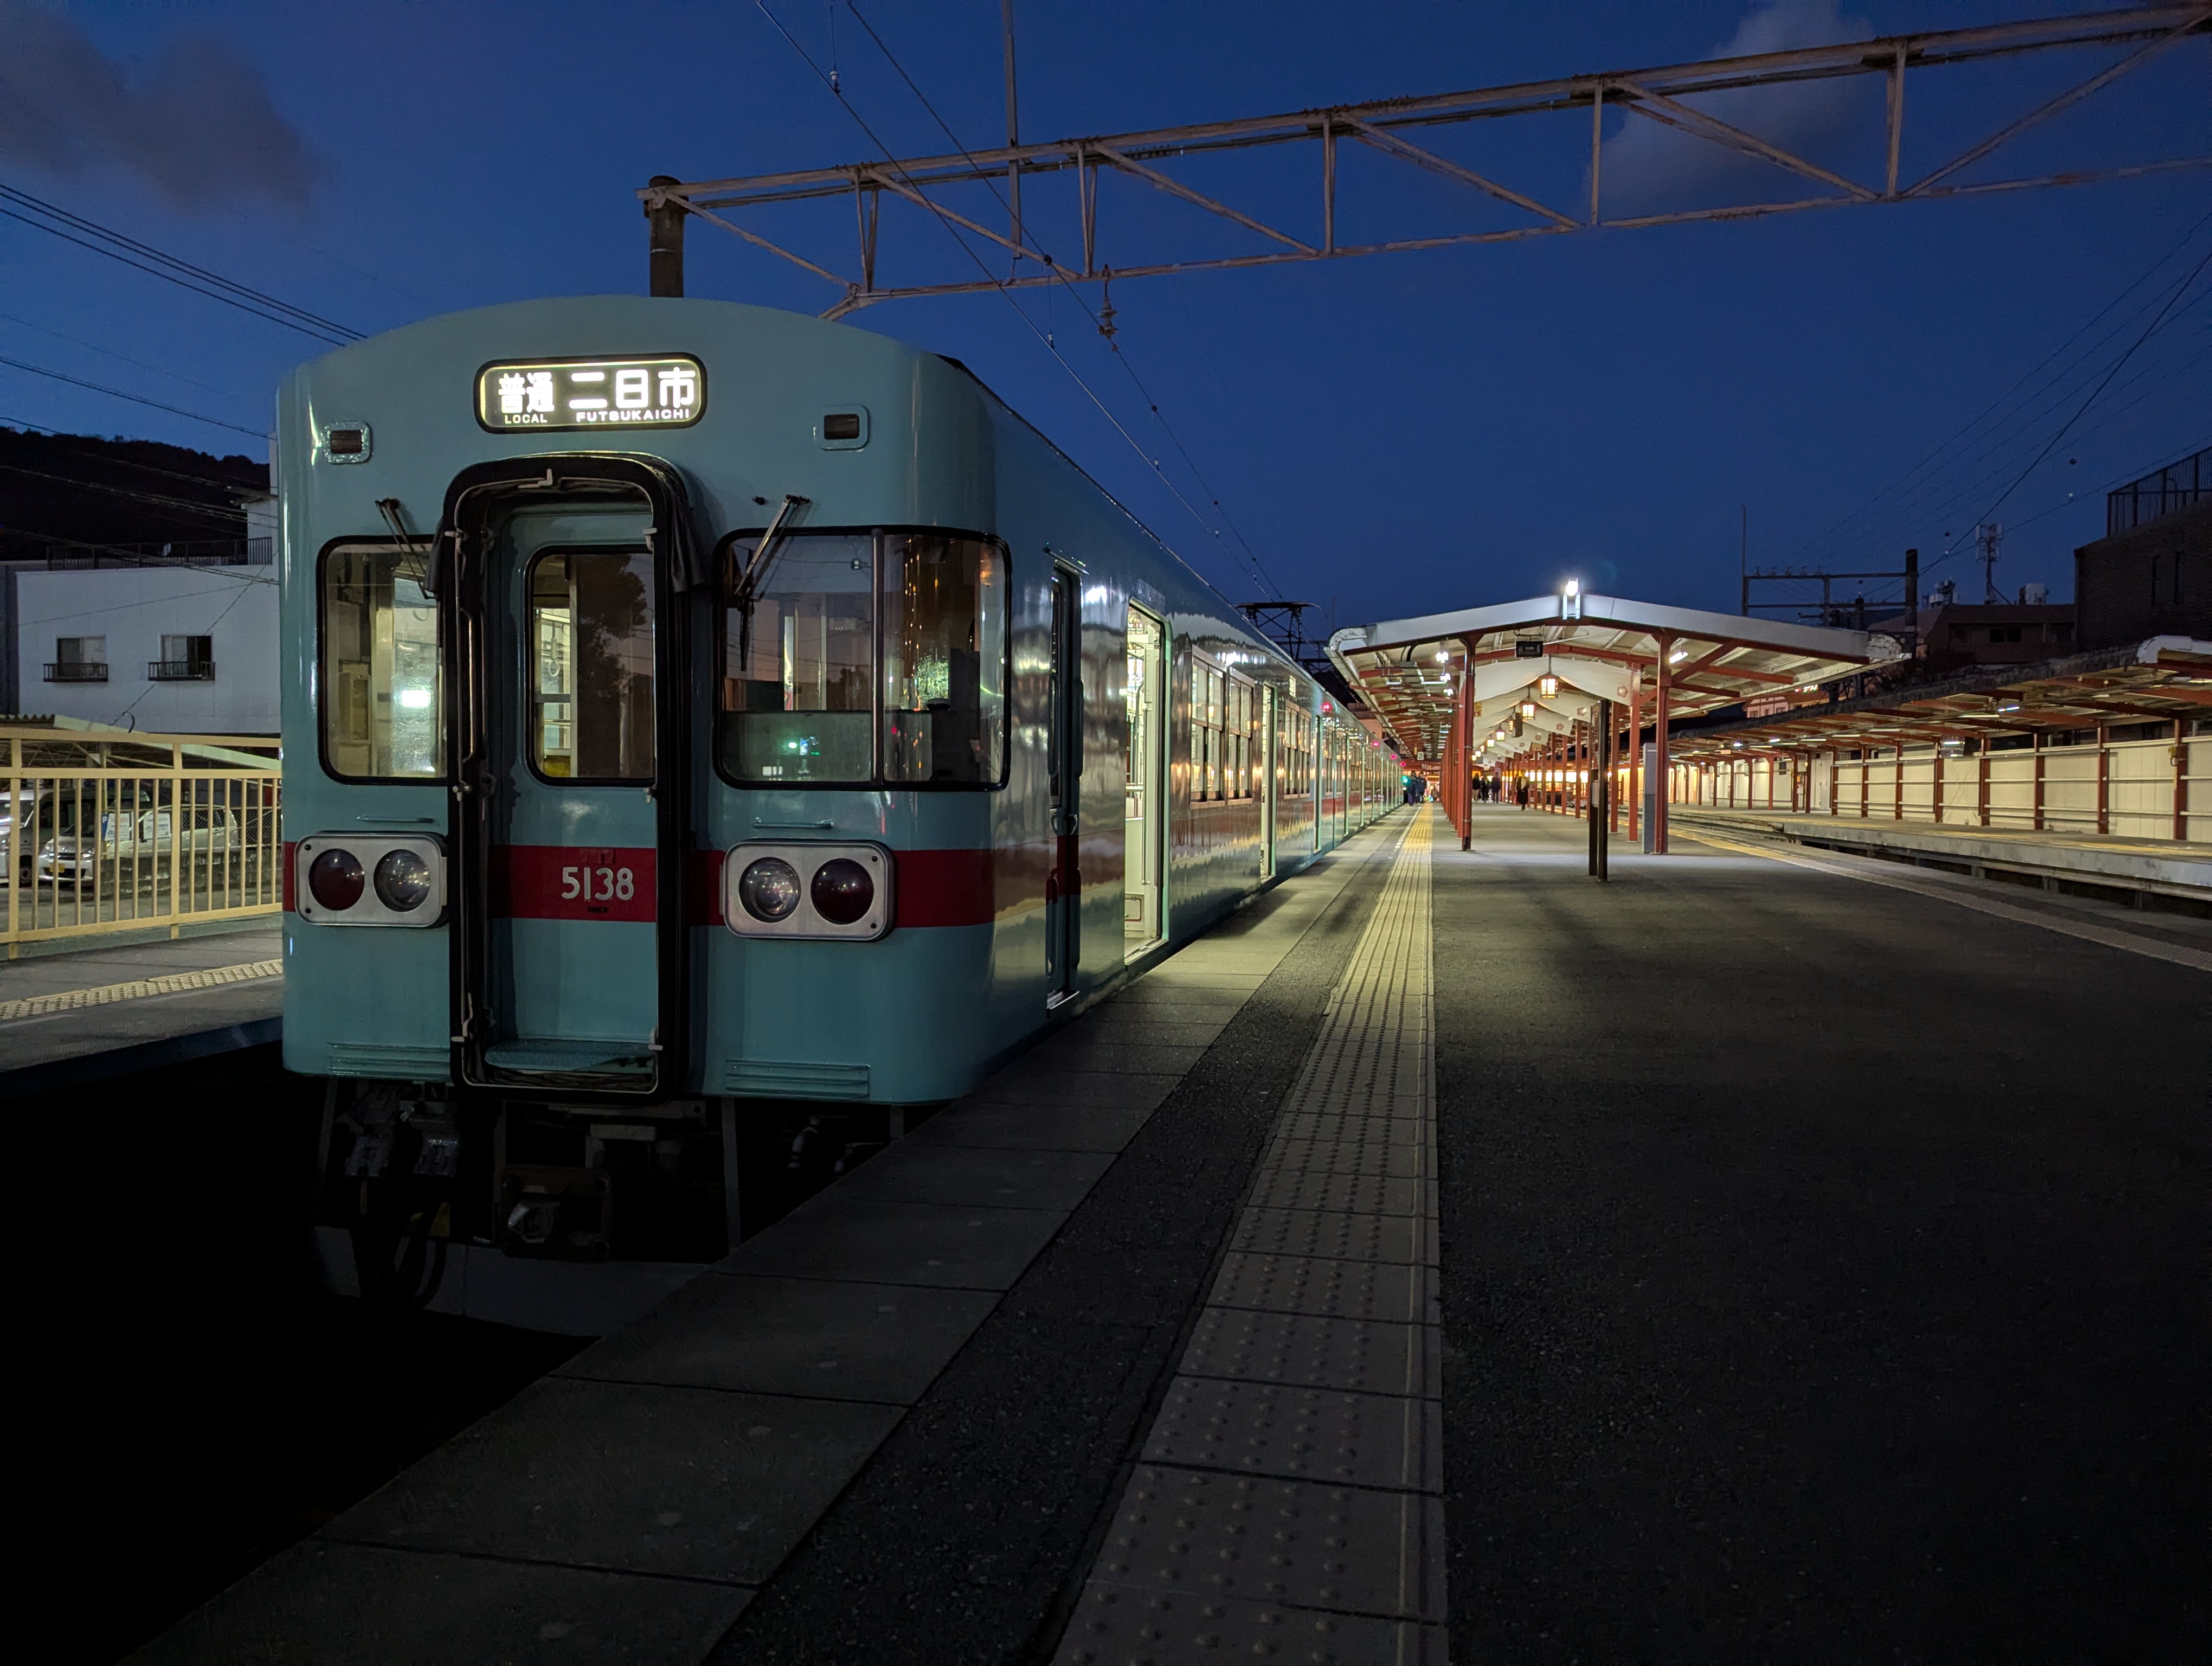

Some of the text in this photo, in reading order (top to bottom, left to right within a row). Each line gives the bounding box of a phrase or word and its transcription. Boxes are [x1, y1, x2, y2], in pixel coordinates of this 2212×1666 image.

[498, 367, 696, 413] 普通 二日市
[505, 409, 689, 424] LOCAL FUTSUKAICHI
[561, 867, 634, 901] 5138
